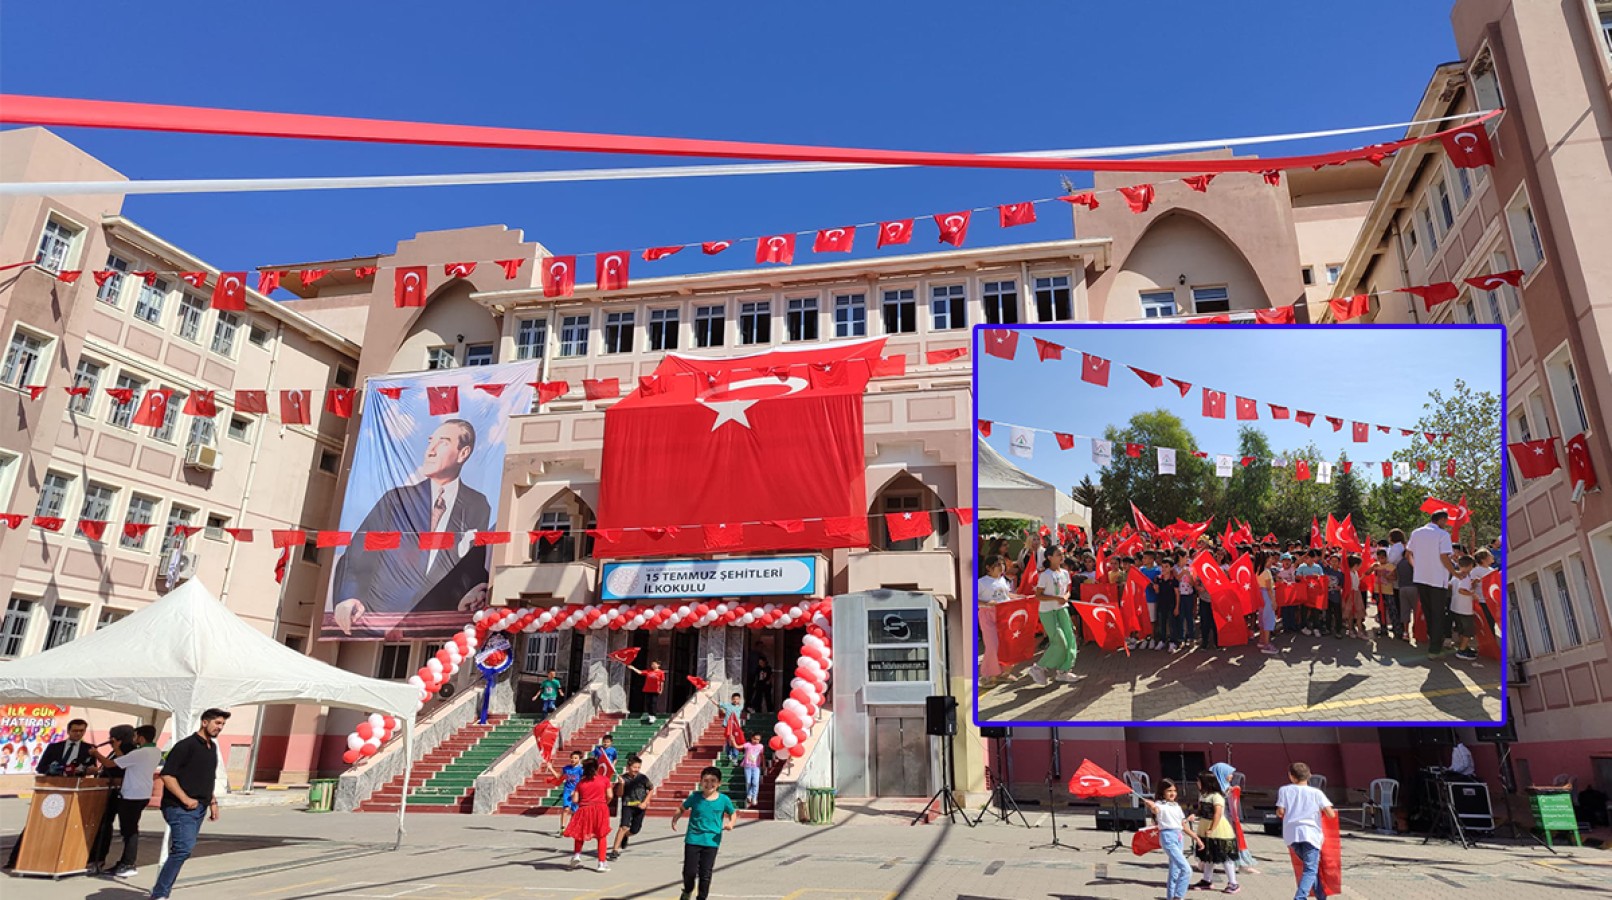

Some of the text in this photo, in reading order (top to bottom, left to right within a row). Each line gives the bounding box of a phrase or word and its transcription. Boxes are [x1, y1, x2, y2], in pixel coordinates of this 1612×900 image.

[645, 567, 783, 581] 15 TEMMUZ ŞEHİTLERİ
[644, 583, 706, 594] İLKOKULU
[1, 716, 56, 727] HATIRASI
